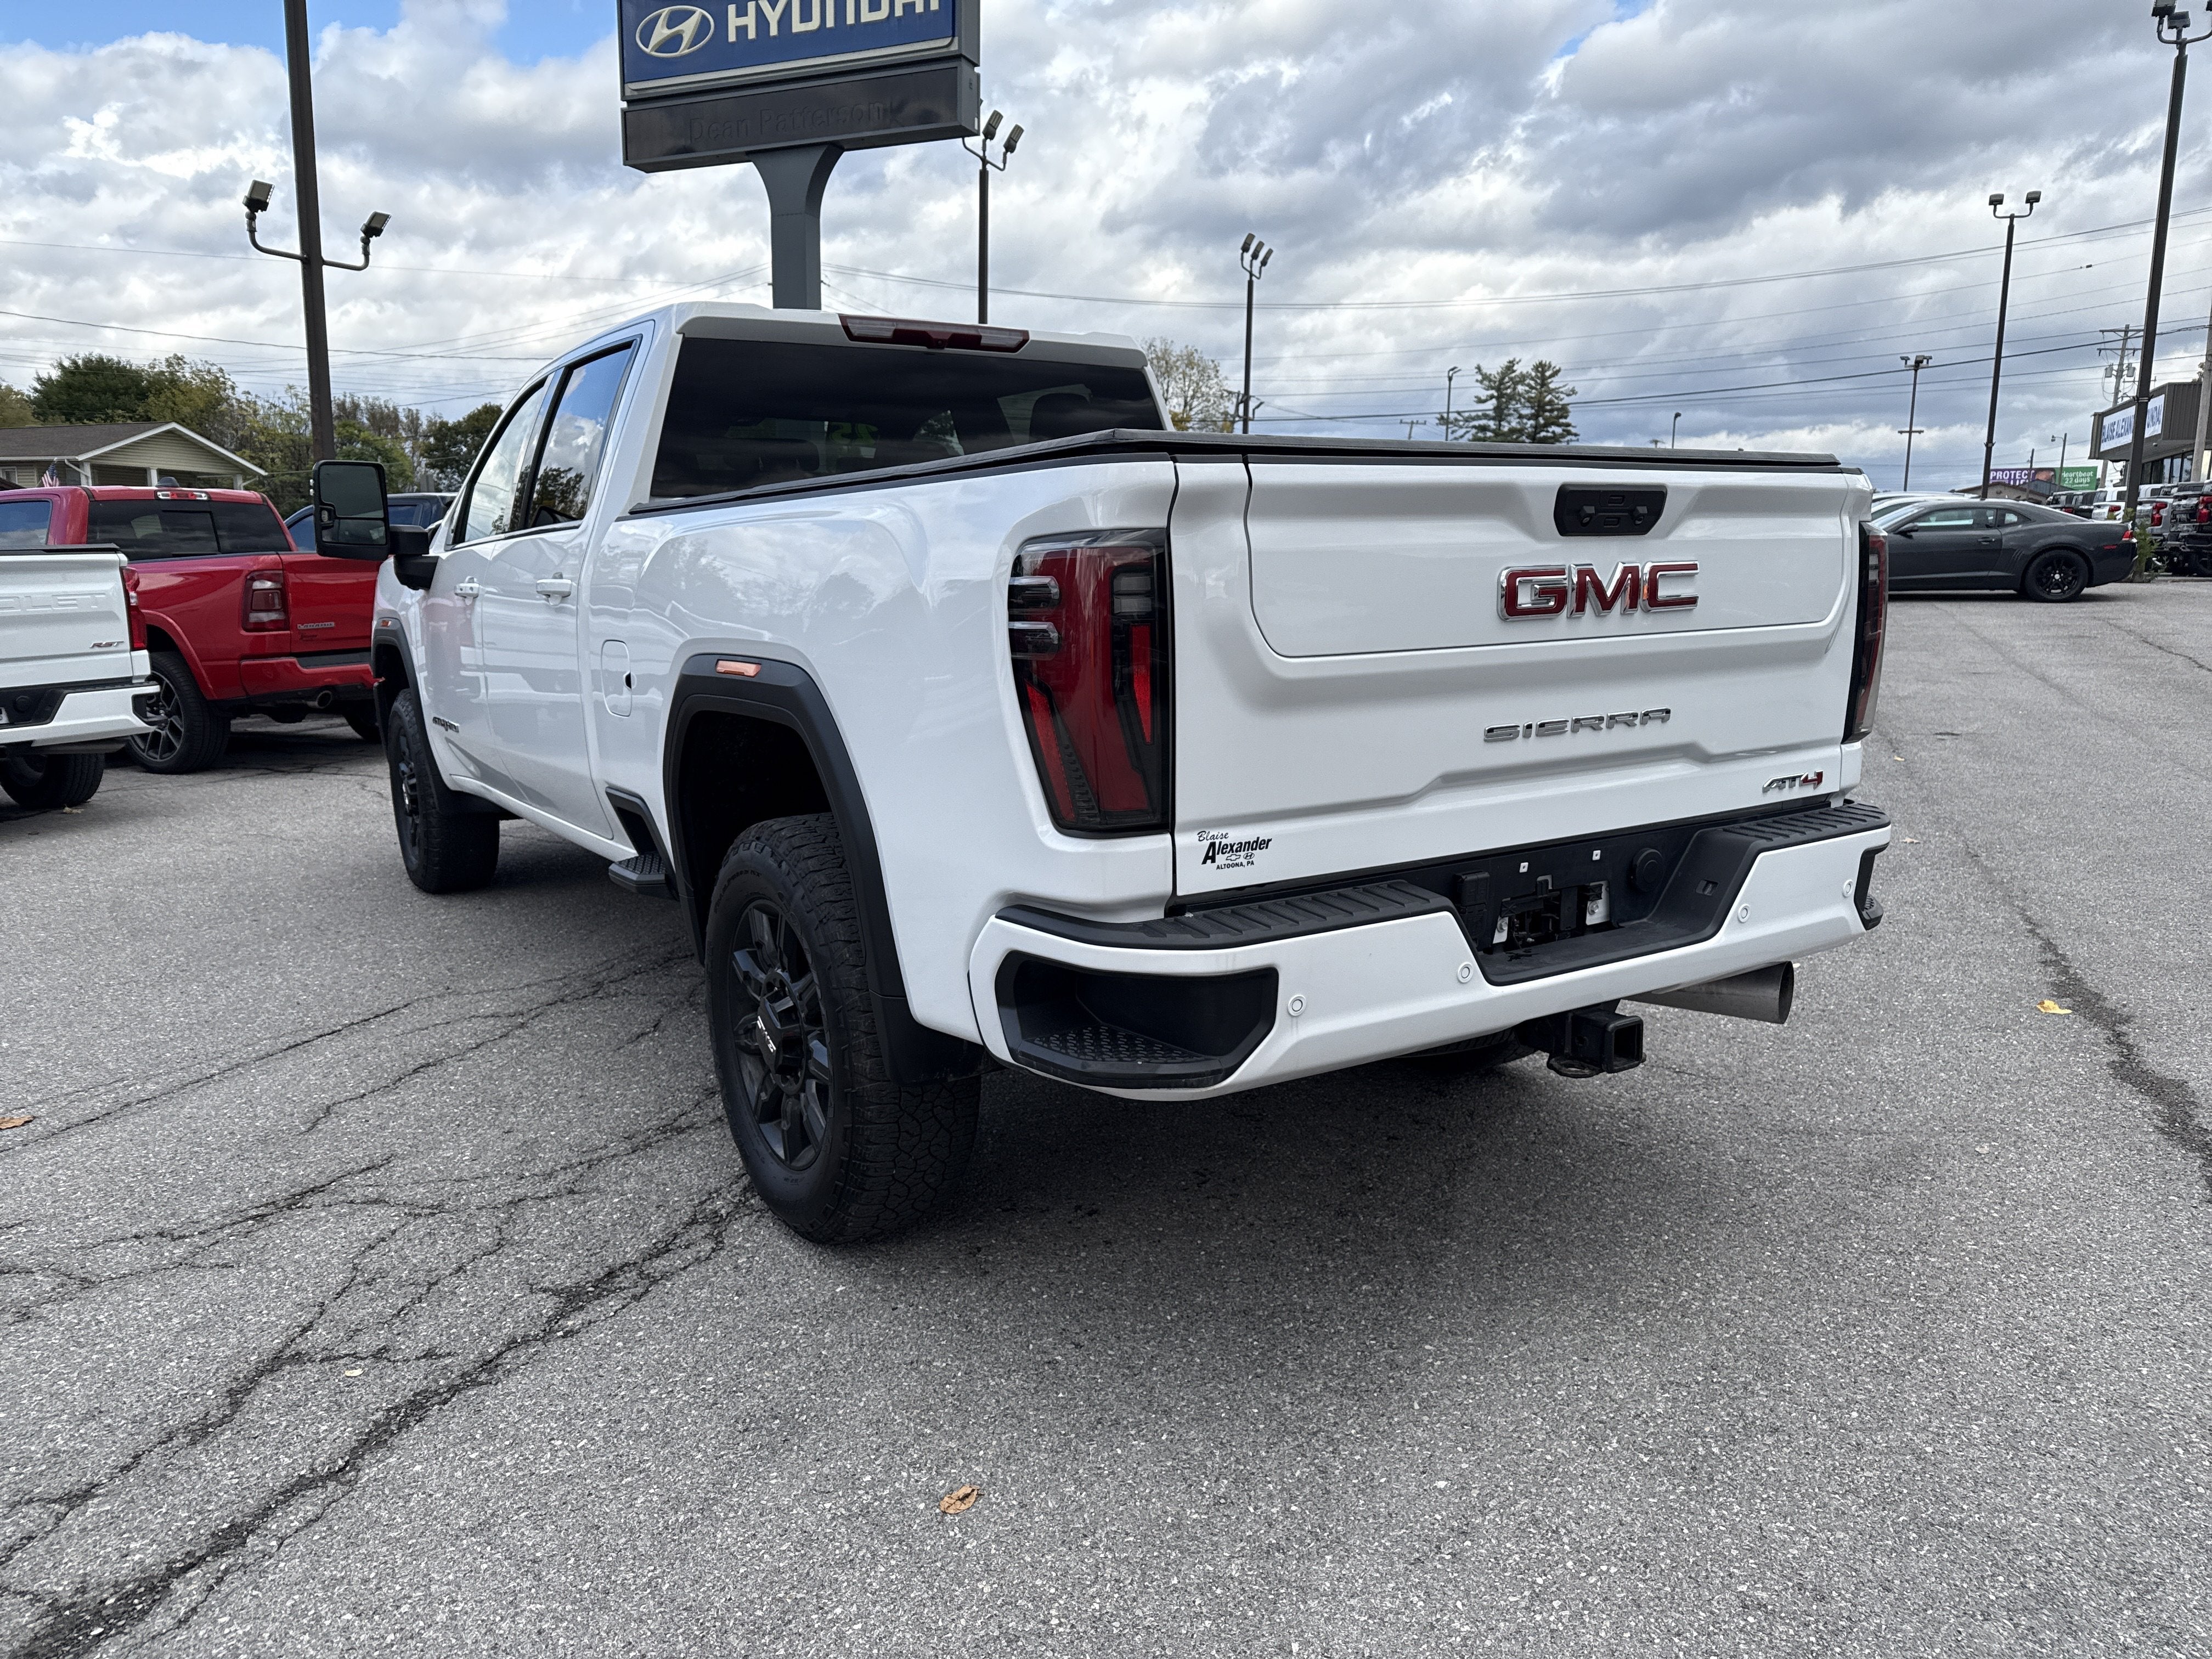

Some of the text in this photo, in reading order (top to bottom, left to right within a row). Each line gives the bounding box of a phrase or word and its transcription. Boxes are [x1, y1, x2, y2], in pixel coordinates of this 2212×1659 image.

[728, 0, 939, 42] HYUND
[689, 102, 885, 143] Dean Patterson
[2115, 415, 2134, 439] ALEXAN
[1990, 470, 2035, 481] PROTECT
[1497, 560, 1700, 621] GMC
[89, 640, 124, 648] RST
[1483, 707, 1672, 742] SIERRA
[1762, 770, 1824, 793] AT4
[1197, 830, 1229, 842] Blaise
[1201, 836, 1272, 865] Alexander
[1216, 861, 1245, 870] ALTOONA,
